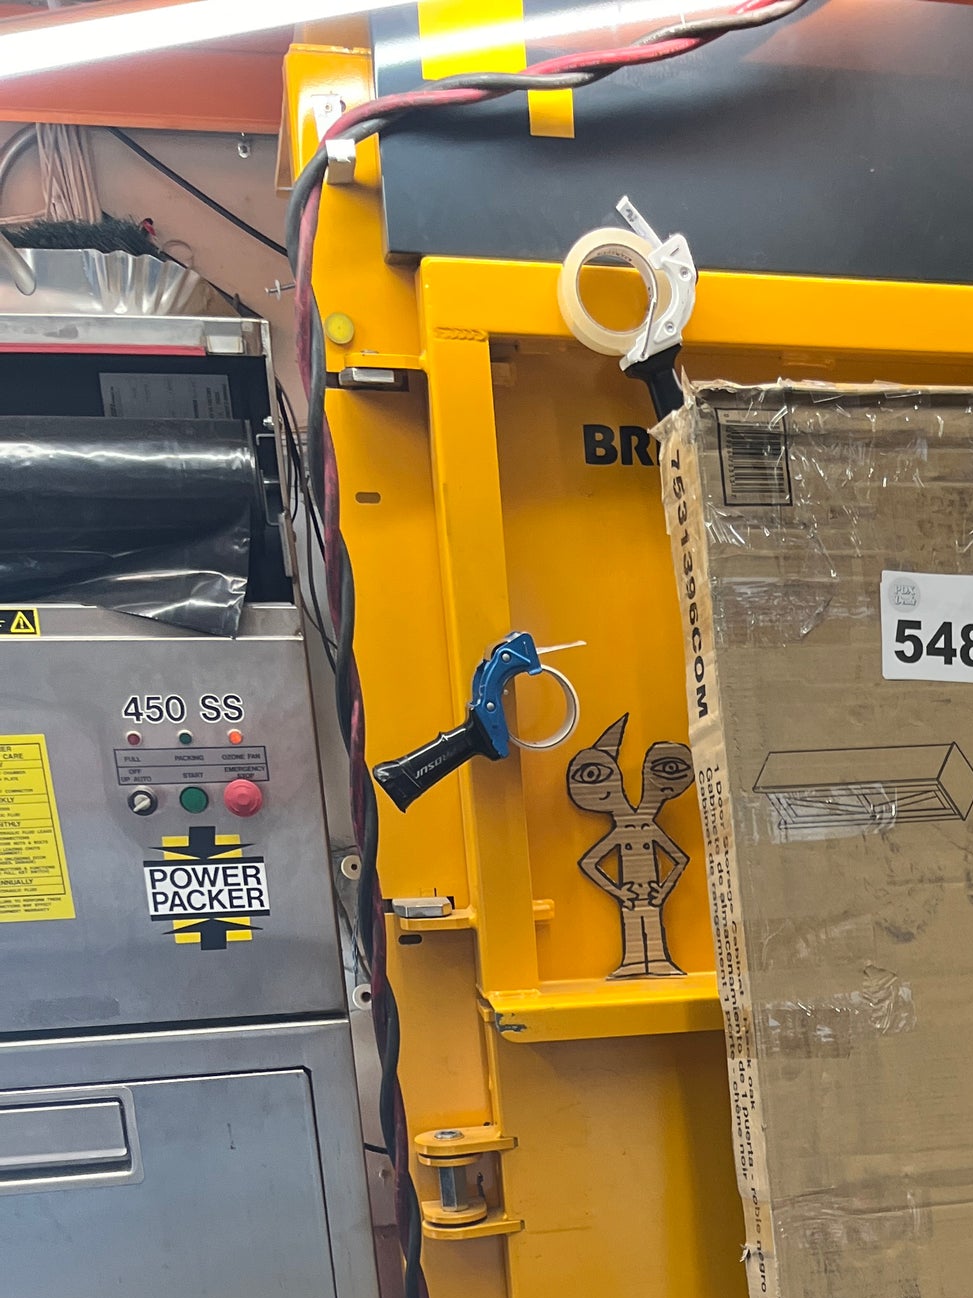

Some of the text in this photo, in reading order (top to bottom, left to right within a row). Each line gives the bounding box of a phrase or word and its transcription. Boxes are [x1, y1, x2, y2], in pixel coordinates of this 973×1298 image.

[583, 425, 660, 467] BR
[668, 447, 709, 720] 7531396COM
[122, 693, 245, 724] 450 SS
[148, 865, 263, 890] POWER
[716, 781, 726, 830] Door
[722, 836, 734, 914] Storage
[150, 887, 266, 913] PACKER
[698, 770, 712, 847] Cabinet
[708, 852, 714, 876] de
[711, 882, 728, 987] rangement
[732, 1082, 742, 1135] chêne
[738, 1143, 748, 1180] noir
[706, 767, 721, 854] Gabinete
[716, 860, 724, 888] de
[720, 892, 742, 1055] almacenamiento
[738, 1060, 745, 1084] de
[742, 1106, 754, 1167] puerta
[751, 1187, 762, 1234] roble
[757, 1240, 768, 1293] negro
